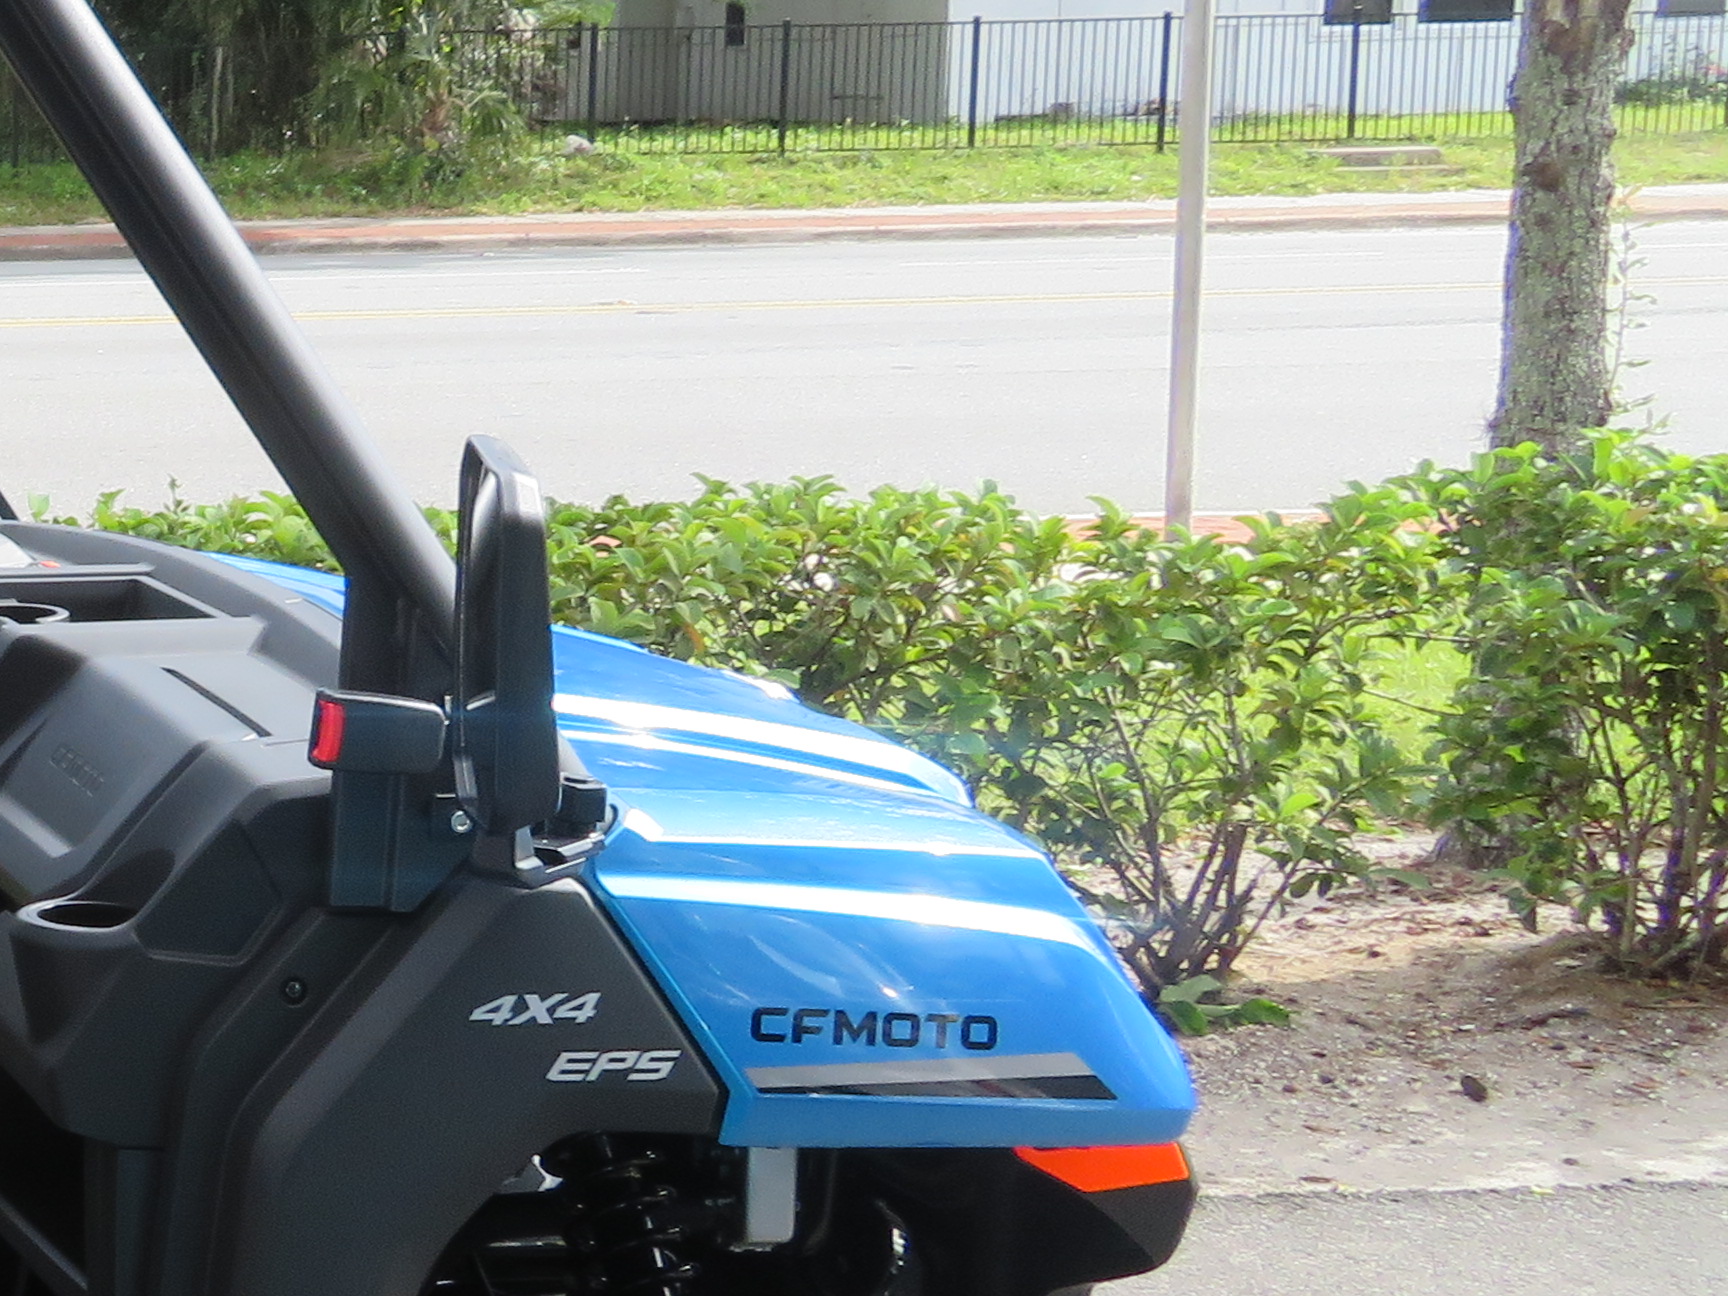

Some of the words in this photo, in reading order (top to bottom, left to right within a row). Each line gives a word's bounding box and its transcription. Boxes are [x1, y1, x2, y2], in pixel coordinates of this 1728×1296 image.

[469, 991, 602, 1026] 4X4
[750, 1006, 1000, 1051] CFMOTO
[546, 1048, 683, 1083] EPS
